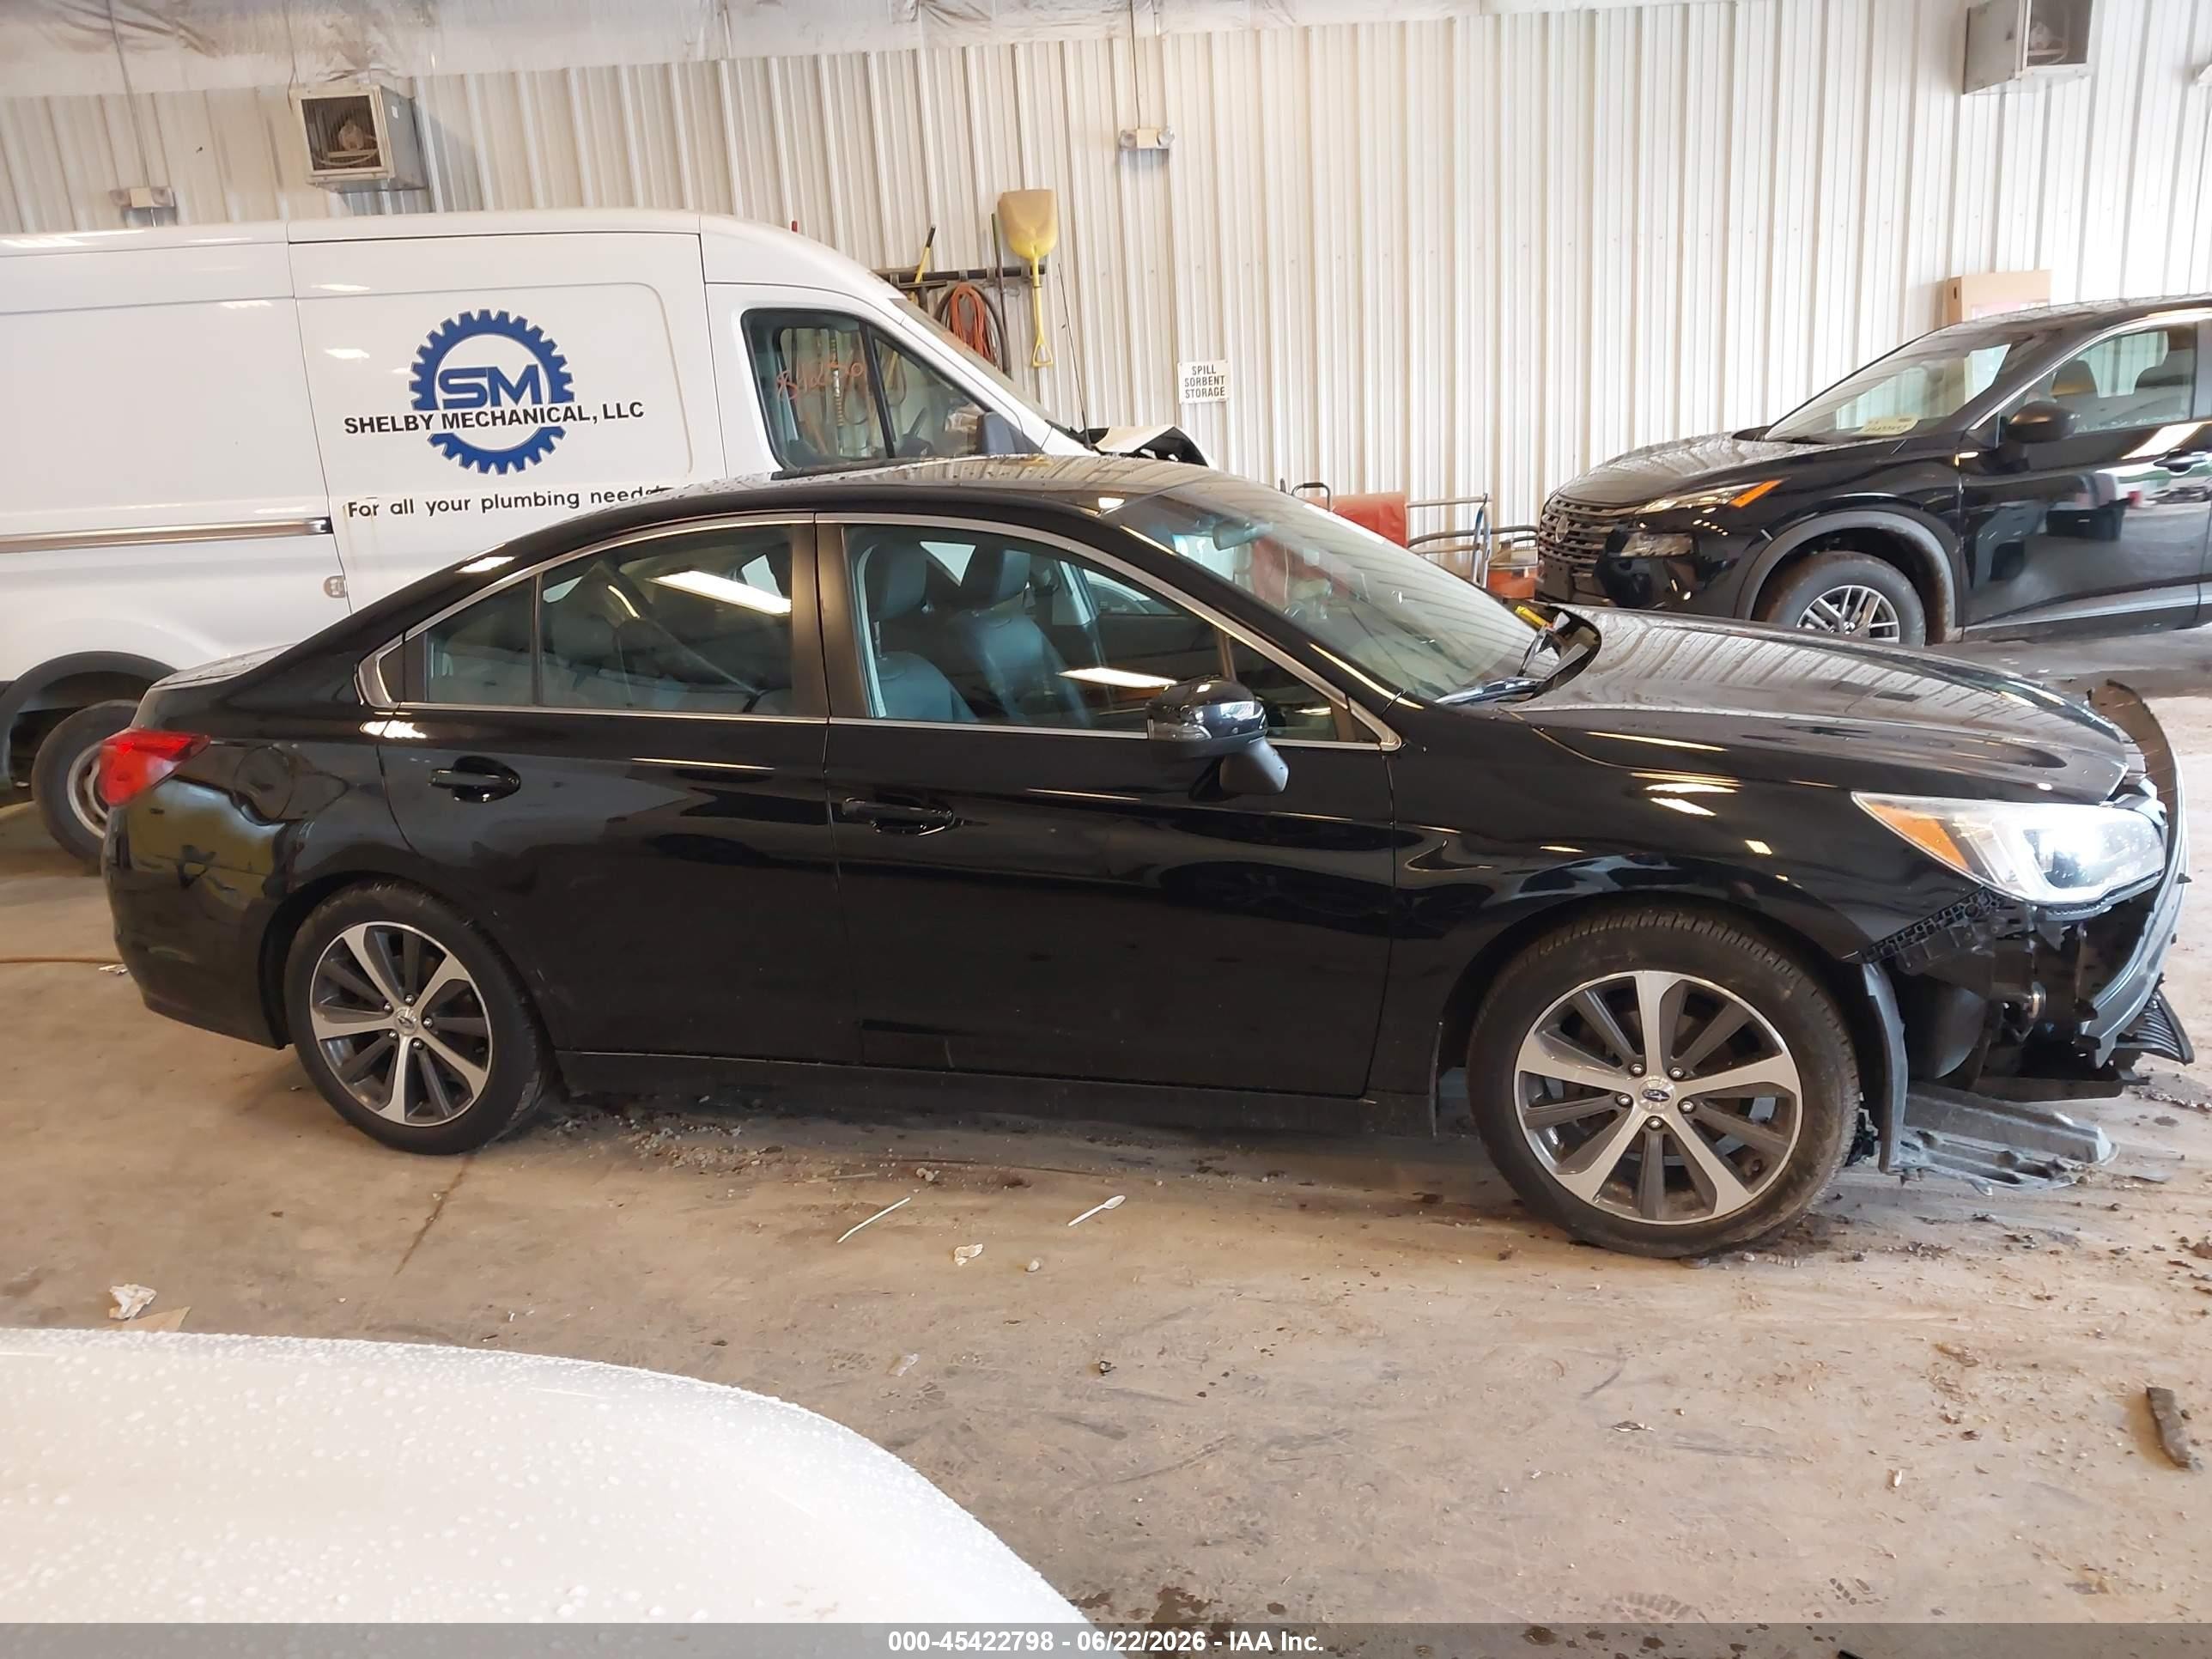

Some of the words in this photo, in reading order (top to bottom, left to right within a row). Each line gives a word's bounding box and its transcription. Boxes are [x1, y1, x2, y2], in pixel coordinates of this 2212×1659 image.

[1192, 364, 1216, 375] SPILL
[438, 364, 543, 410] SM
[1184, 375, 1225, 387] SORBENT
[1185, 386, 1225, 398] STORAGE
[344, 414, 434, 434] SHELBY
[441, 405, 598, 429] MECHANICAL,
[602, 401, 644, 420] LLC
[348, 501, 380, 517] For
[390, 498, 414, 515] all
[425, 498, 471, 517] your
[481, 490, 580, 514] plumbing
